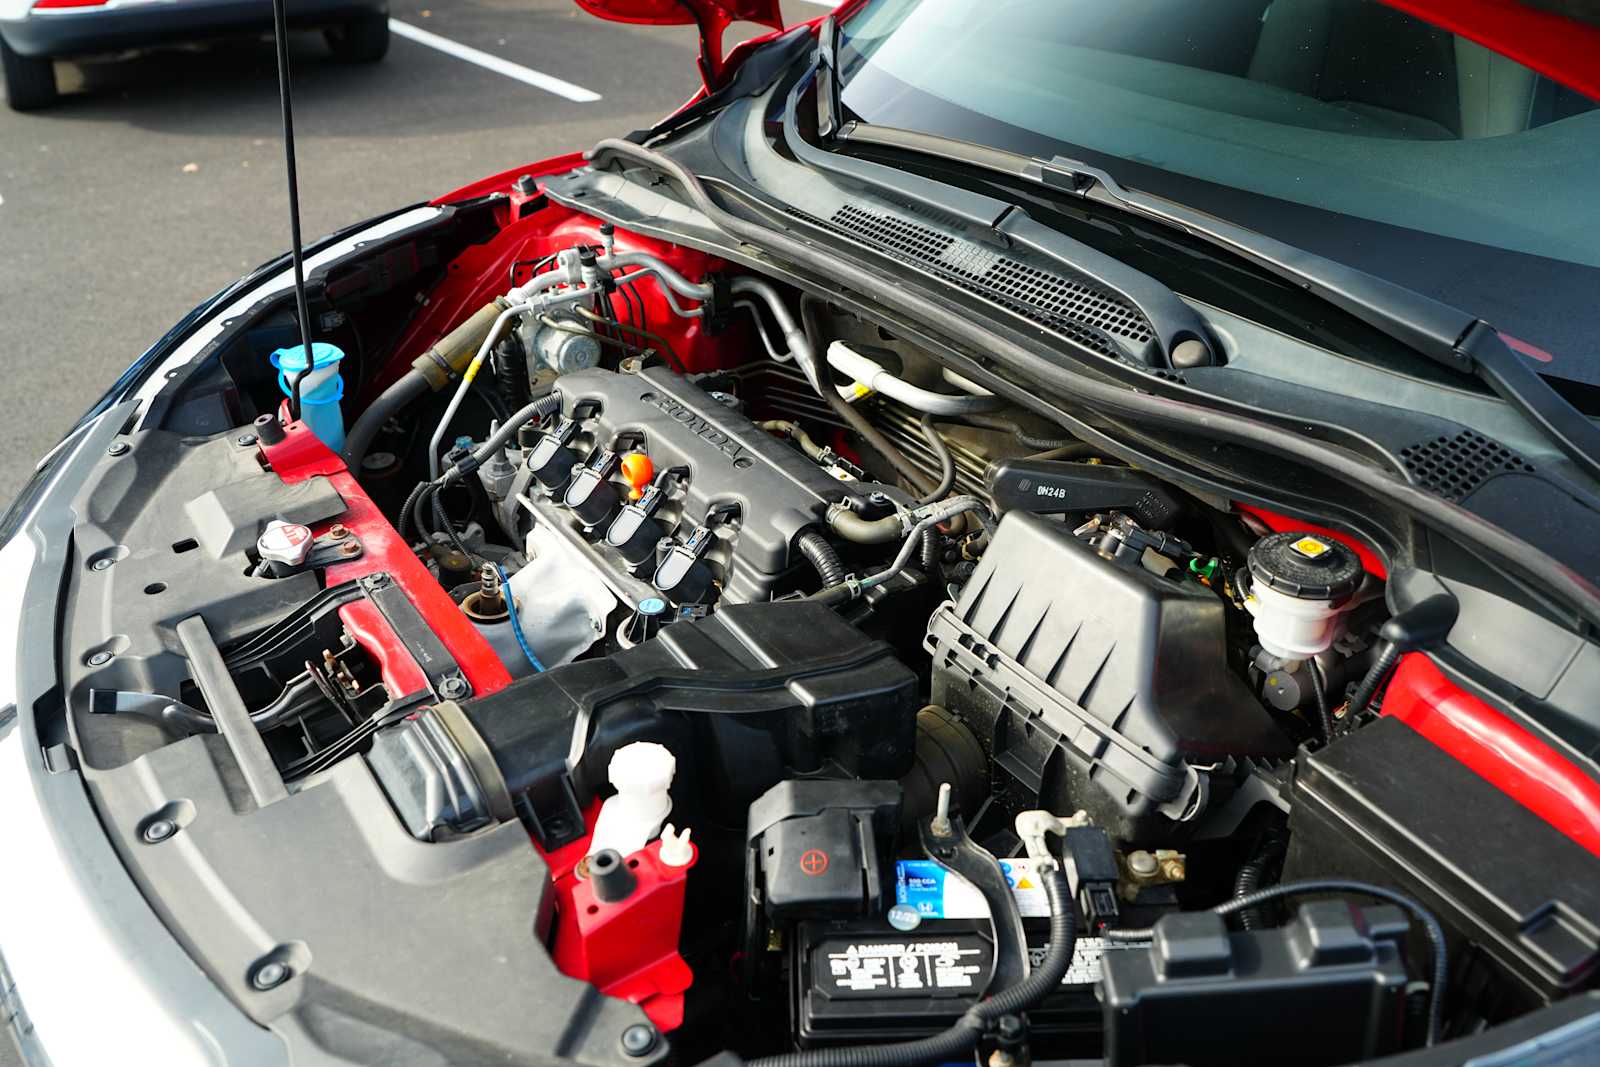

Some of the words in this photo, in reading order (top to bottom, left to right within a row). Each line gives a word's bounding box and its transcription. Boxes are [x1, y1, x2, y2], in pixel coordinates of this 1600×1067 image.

[653, 397, 743, 460] HONDA
[858, 943, 905, 955] DANGER
[915, 942, 958, 953] POISON
